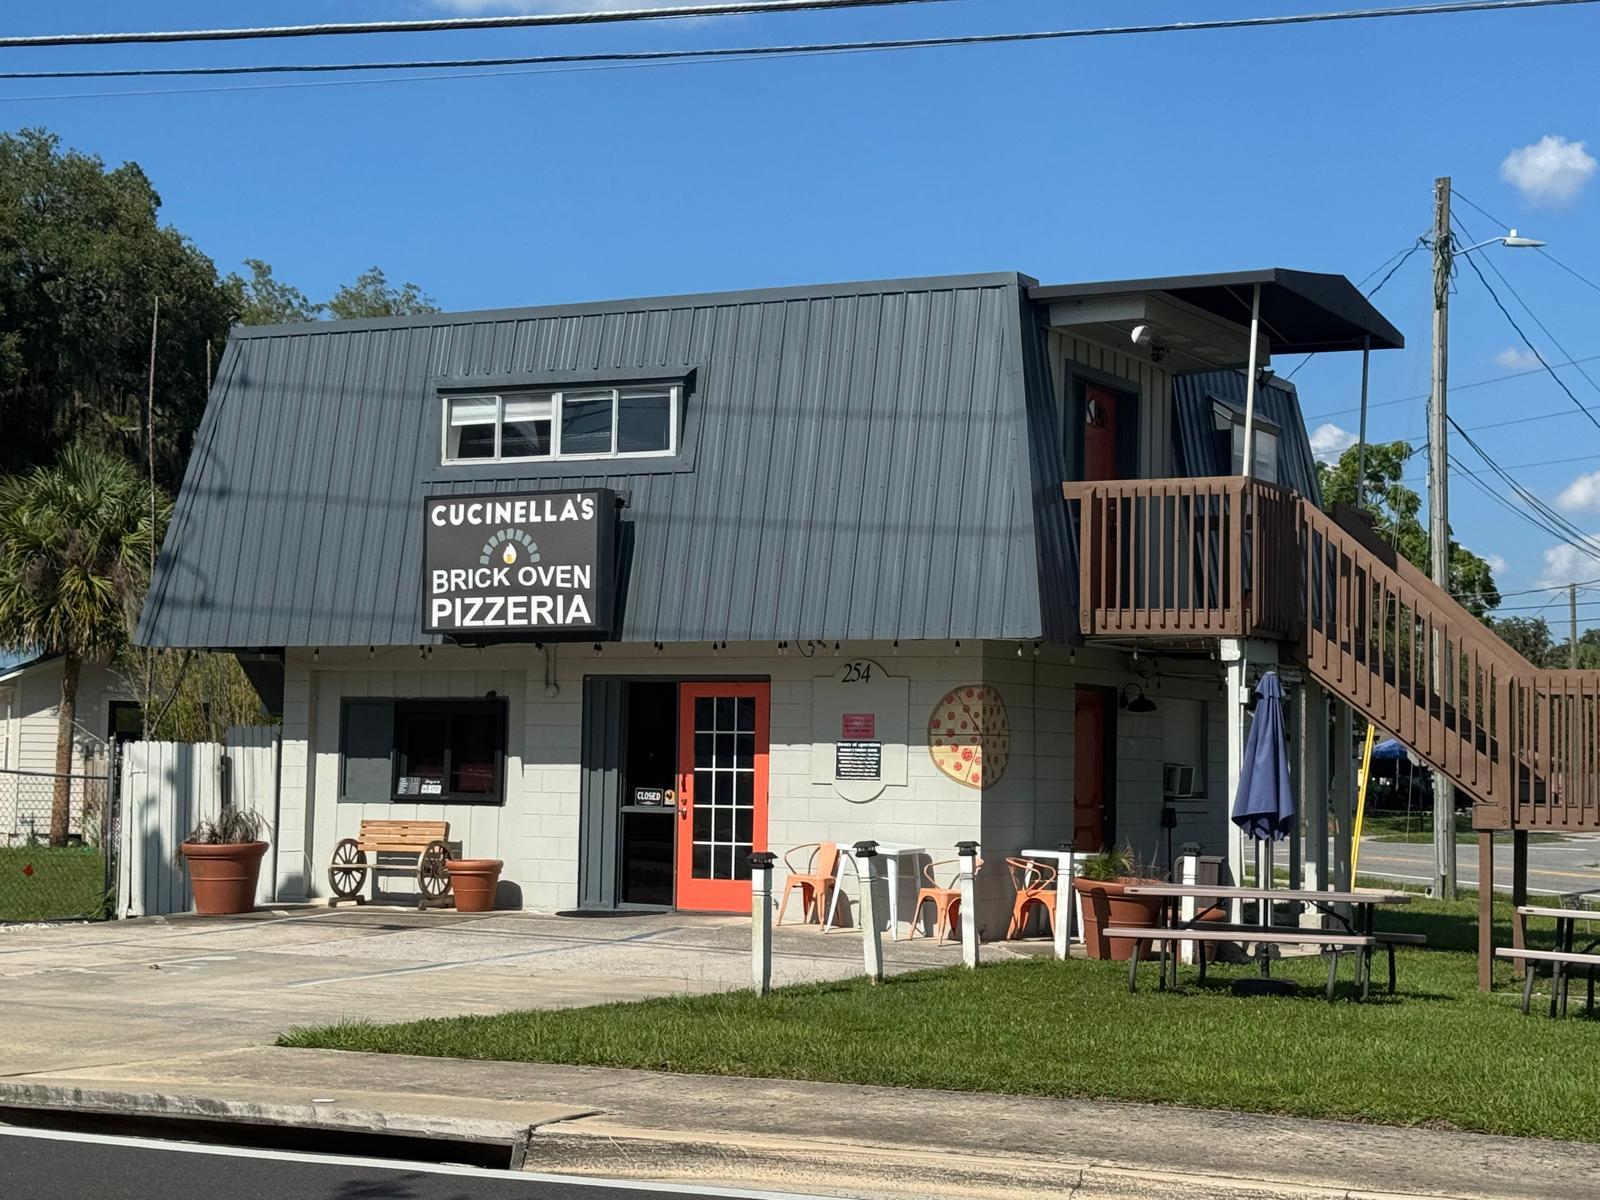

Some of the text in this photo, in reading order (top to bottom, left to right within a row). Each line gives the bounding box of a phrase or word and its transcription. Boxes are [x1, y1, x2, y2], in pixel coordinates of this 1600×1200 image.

[431, 494, 594, 527] CUCINELLA'S
[432, 564, 591, 594] BRICK OVEN
[431, 594, 592, 628] PIZZERIA
[841, 662, 871, 684] 254
[637, 791, 661, 801] CLOSED
